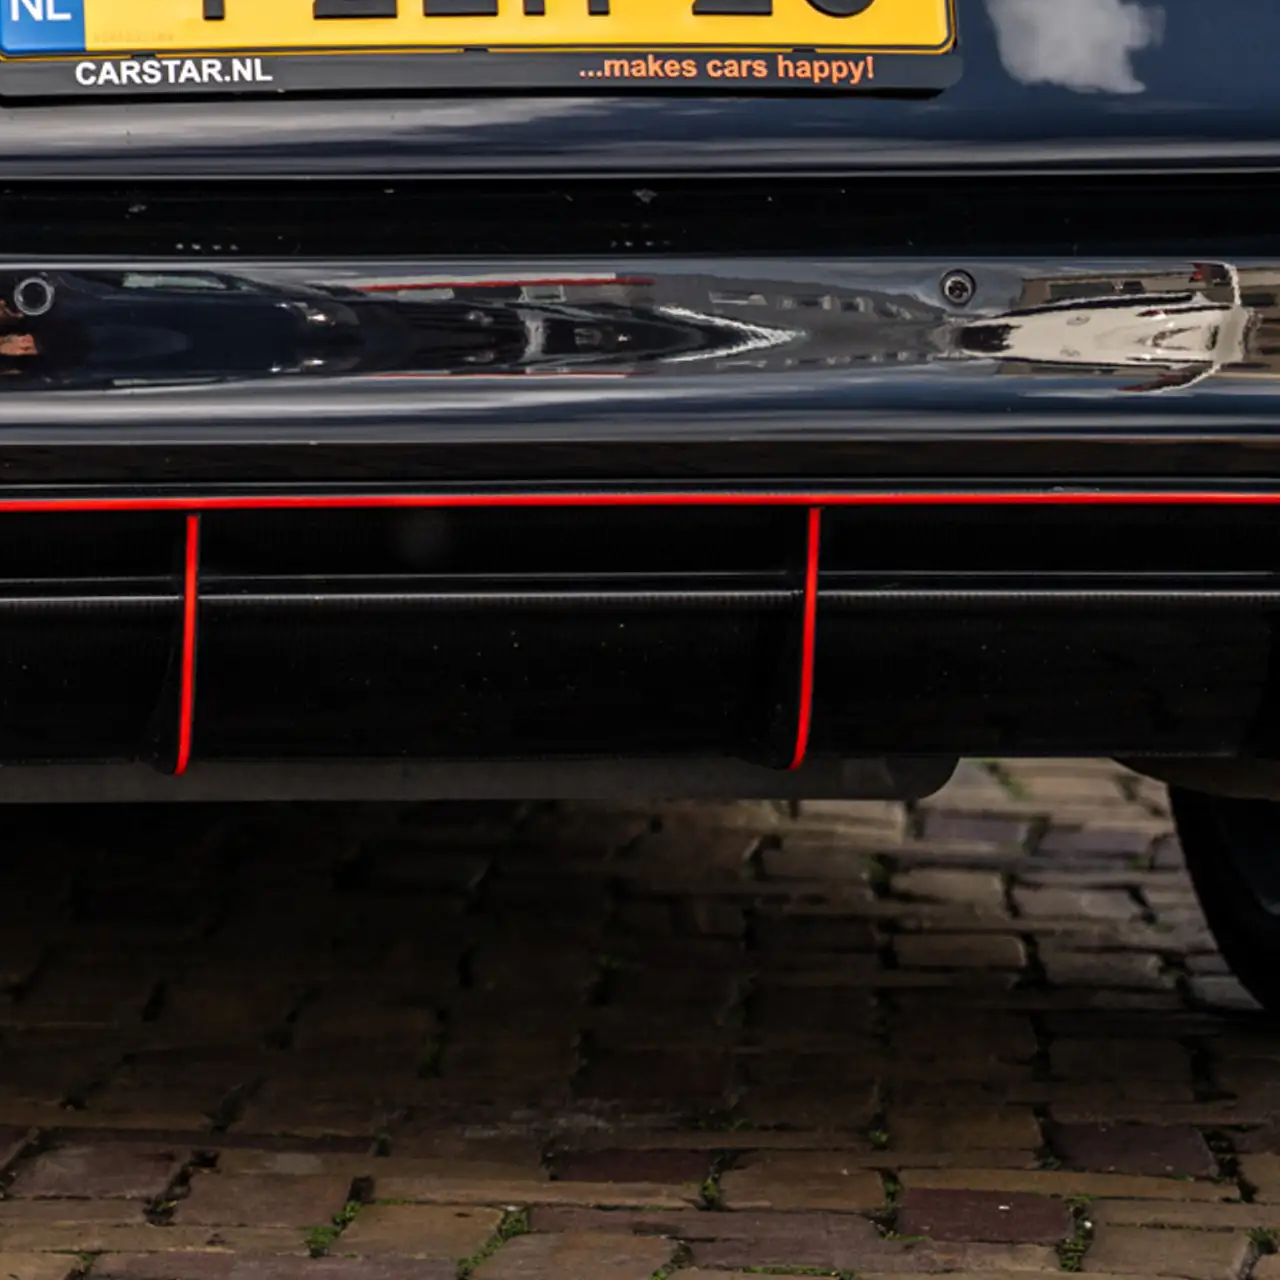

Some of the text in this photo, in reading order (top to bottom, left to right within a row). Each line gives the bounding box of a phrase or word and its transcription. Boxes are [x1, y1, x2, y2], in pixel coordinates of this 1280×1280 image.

[75, 58, 273, 86] CARSTAR.NL
[579, 53, 875, 85] ...makes cars happy!
